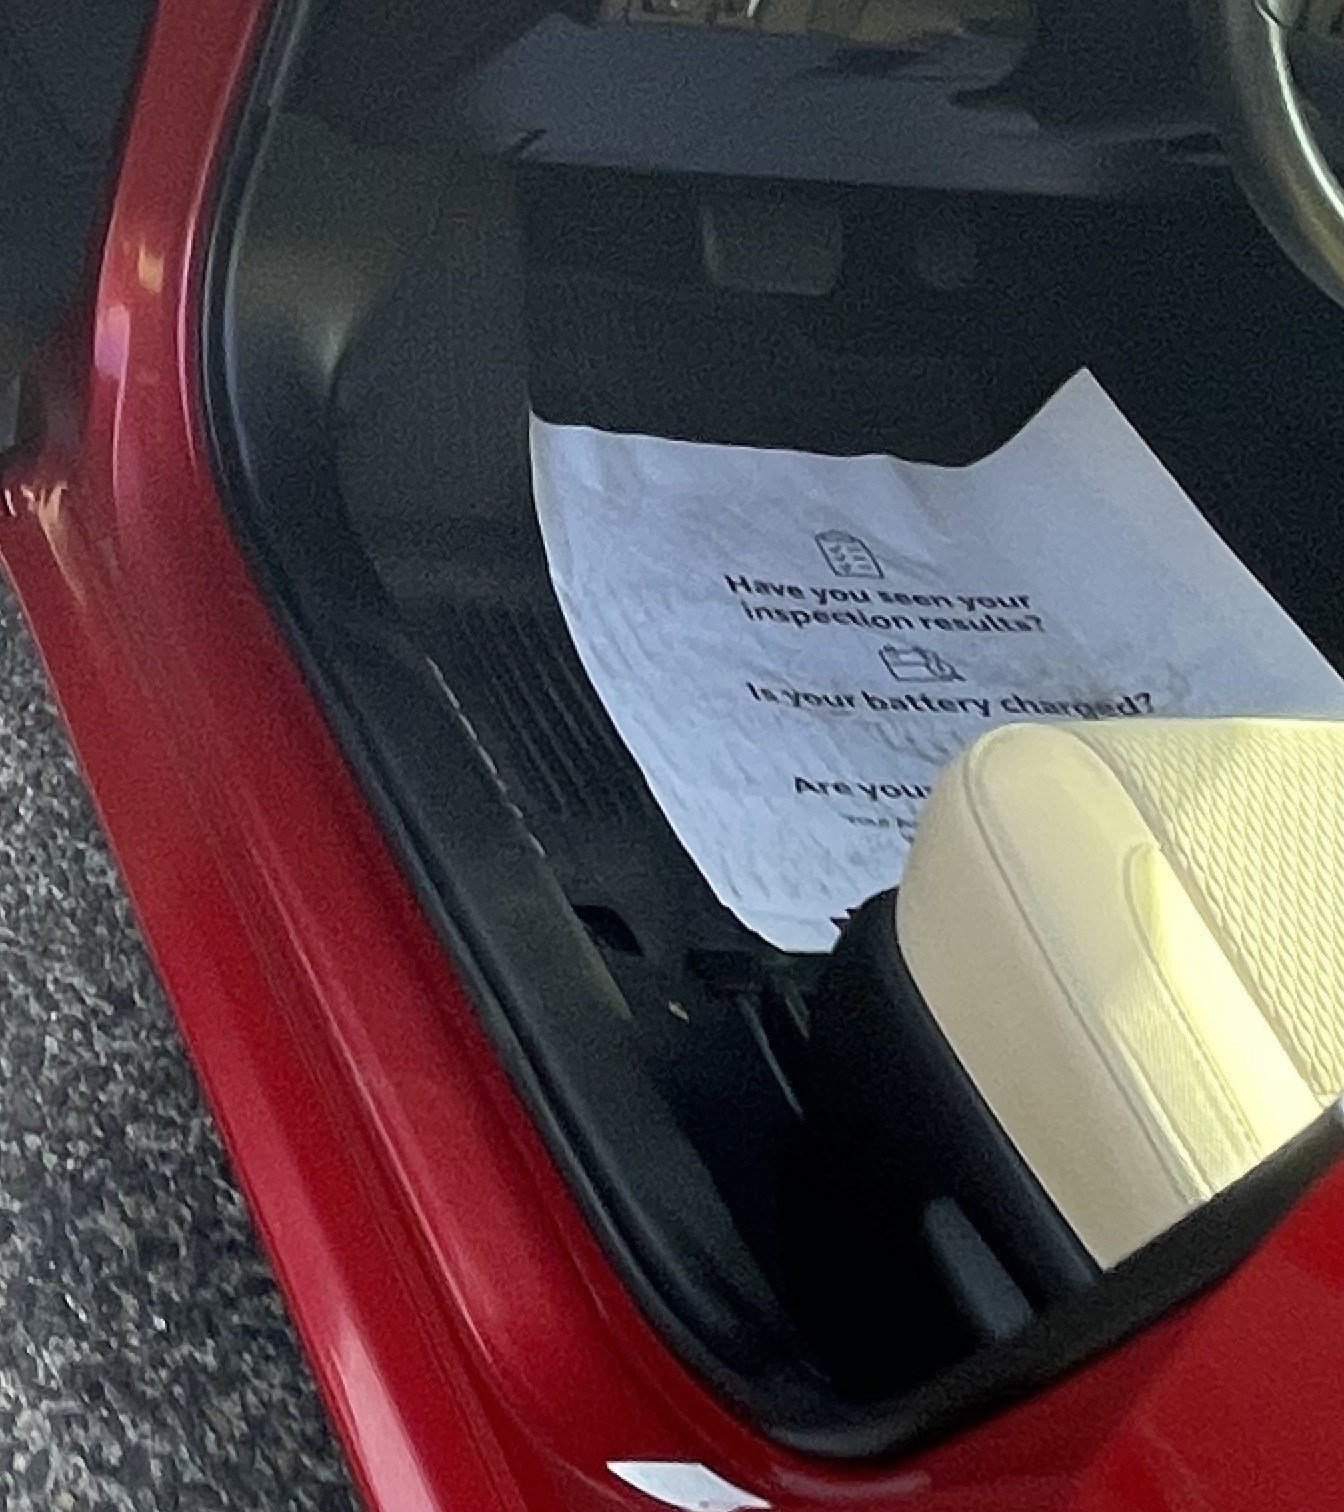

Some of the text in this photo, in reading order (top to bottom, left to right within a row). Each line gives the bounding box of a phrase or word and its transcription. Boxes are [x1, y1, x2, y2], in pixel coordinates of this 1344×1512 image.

[724, 574, 1031, 612] Have you seen your
[740, 599, 1046, 634] inspection results?
[745, 681, 1156, 720] Is your battery charged?
[794, 776, 855, 796] Are
